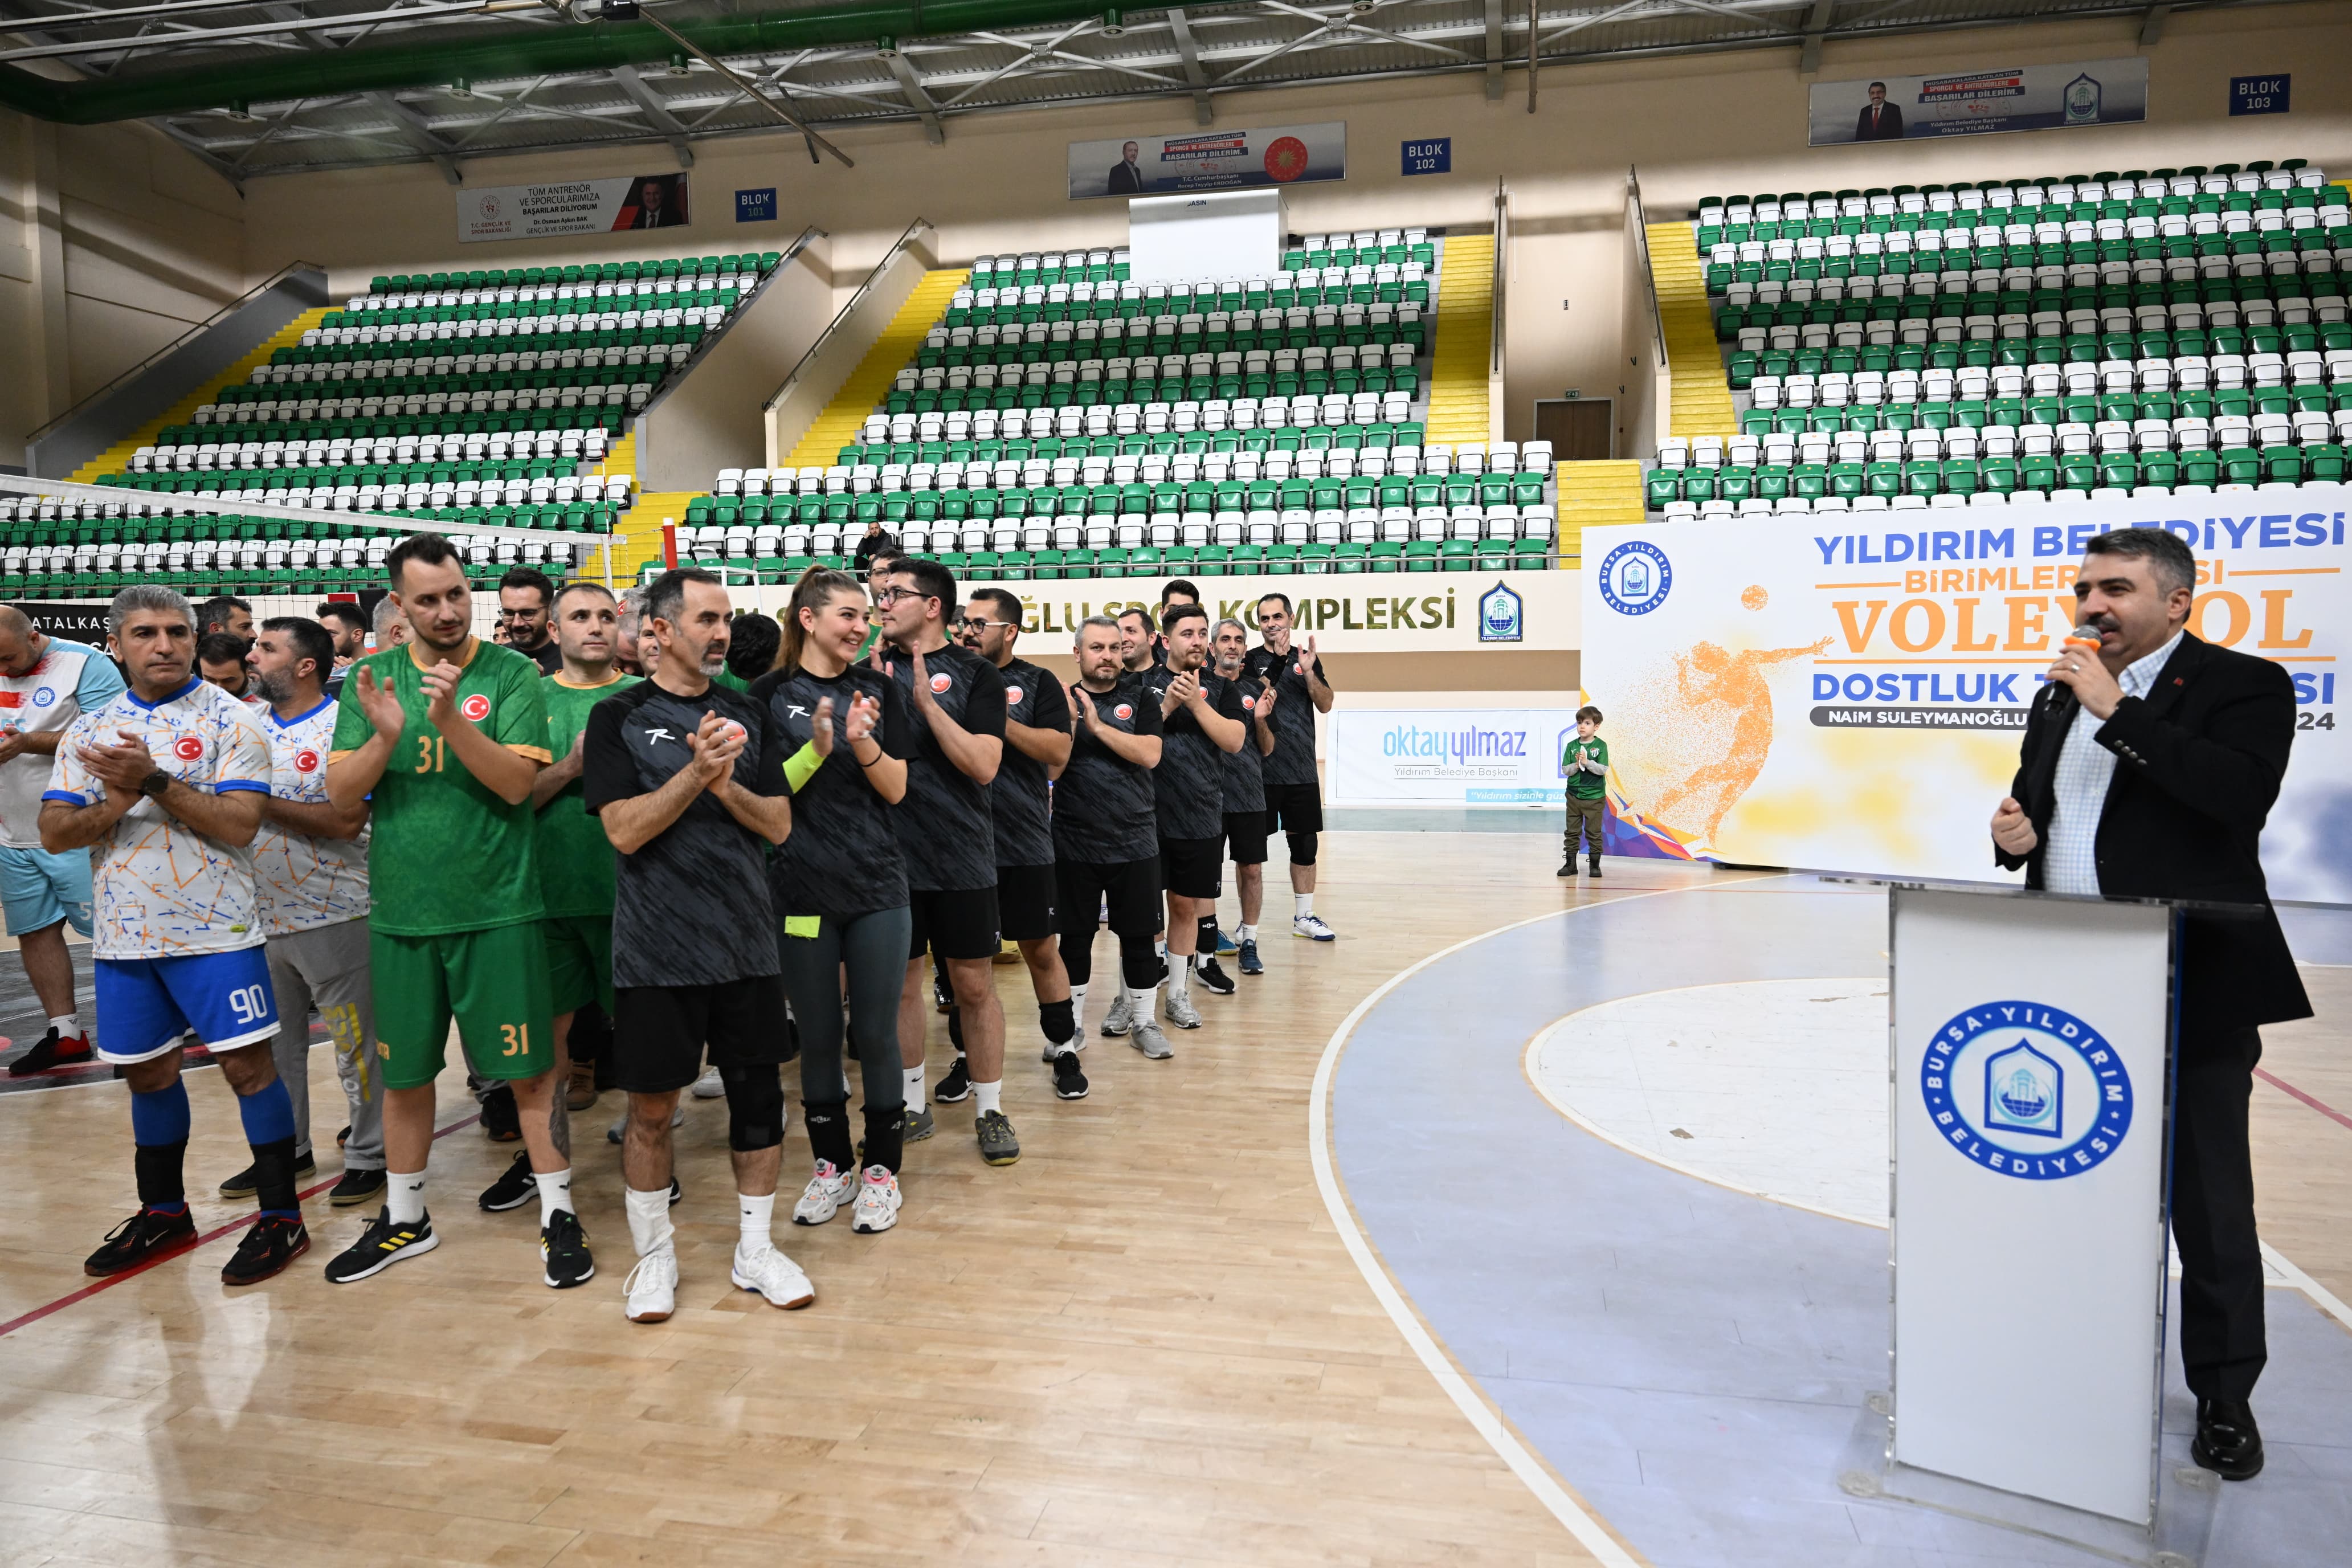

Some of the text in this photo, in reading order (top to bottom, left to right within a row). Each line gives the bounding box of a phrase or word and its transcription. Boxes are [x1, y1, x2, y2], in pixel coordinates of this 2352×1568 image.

[1964, 80, 2009, 89] ANTRENÖRLERE
[1978, 88, 2018, 98] DİLERİM.
[2239, 80, 2280, 95] BLOK
[2247, 97, 2271, 109] 103
[1408, 144, 1443, 157] BLOK
[1416, 158, 1435, 169] 102
[520, 193, 600, 206] VE SPORCULARIMIZA
[528, 184, 590, 197] TÜM ANTRENÖR
[741, 193, 770, 205] BLOK
[522, 203, 598, 216] BAŞARILAR DİLİYORUM
[748, 207, 765, 217] 101
[526, 226, 550, 235] GENÇLİK
[1814, 512, 2346, 565] YILDIRIM BEDİYESİ
[1601, 550, 1622, 583] BURSA
[1627, 544, 1669, 578] YILDIRIM
[1905, 565, 2081, 594] BİRİMLER
[1604, 587, 1668, 614] BELEDİYESİ
[1832, 589, 2314, 653] VOLEOL
[1812, 672, 2019, 703] DOSTLUK
[1877, 709, 2027, 726] SÜLEYMANOĞLU
[2297, 712, 2335, 730] 24
[415, 735, 444, 774] 31
[1383, 724, 1526, 766] oktay yılmaz
[1394, 767, 1518, 777] Yıldırım Belediye Başkanı
[1514, 791, 1544, 800] sizinle
[1546, 791, 1566, 801] güz
[228, 983, 268, 1024] 90
[500, 1023, 529, 1056] 31
[1927, 1016, 1983, 1089] BURSA
[2000, 1007, 2124, 1101] YILDIRIM
[1937, 1110, 2118, 1175] BELEDİYESİ
